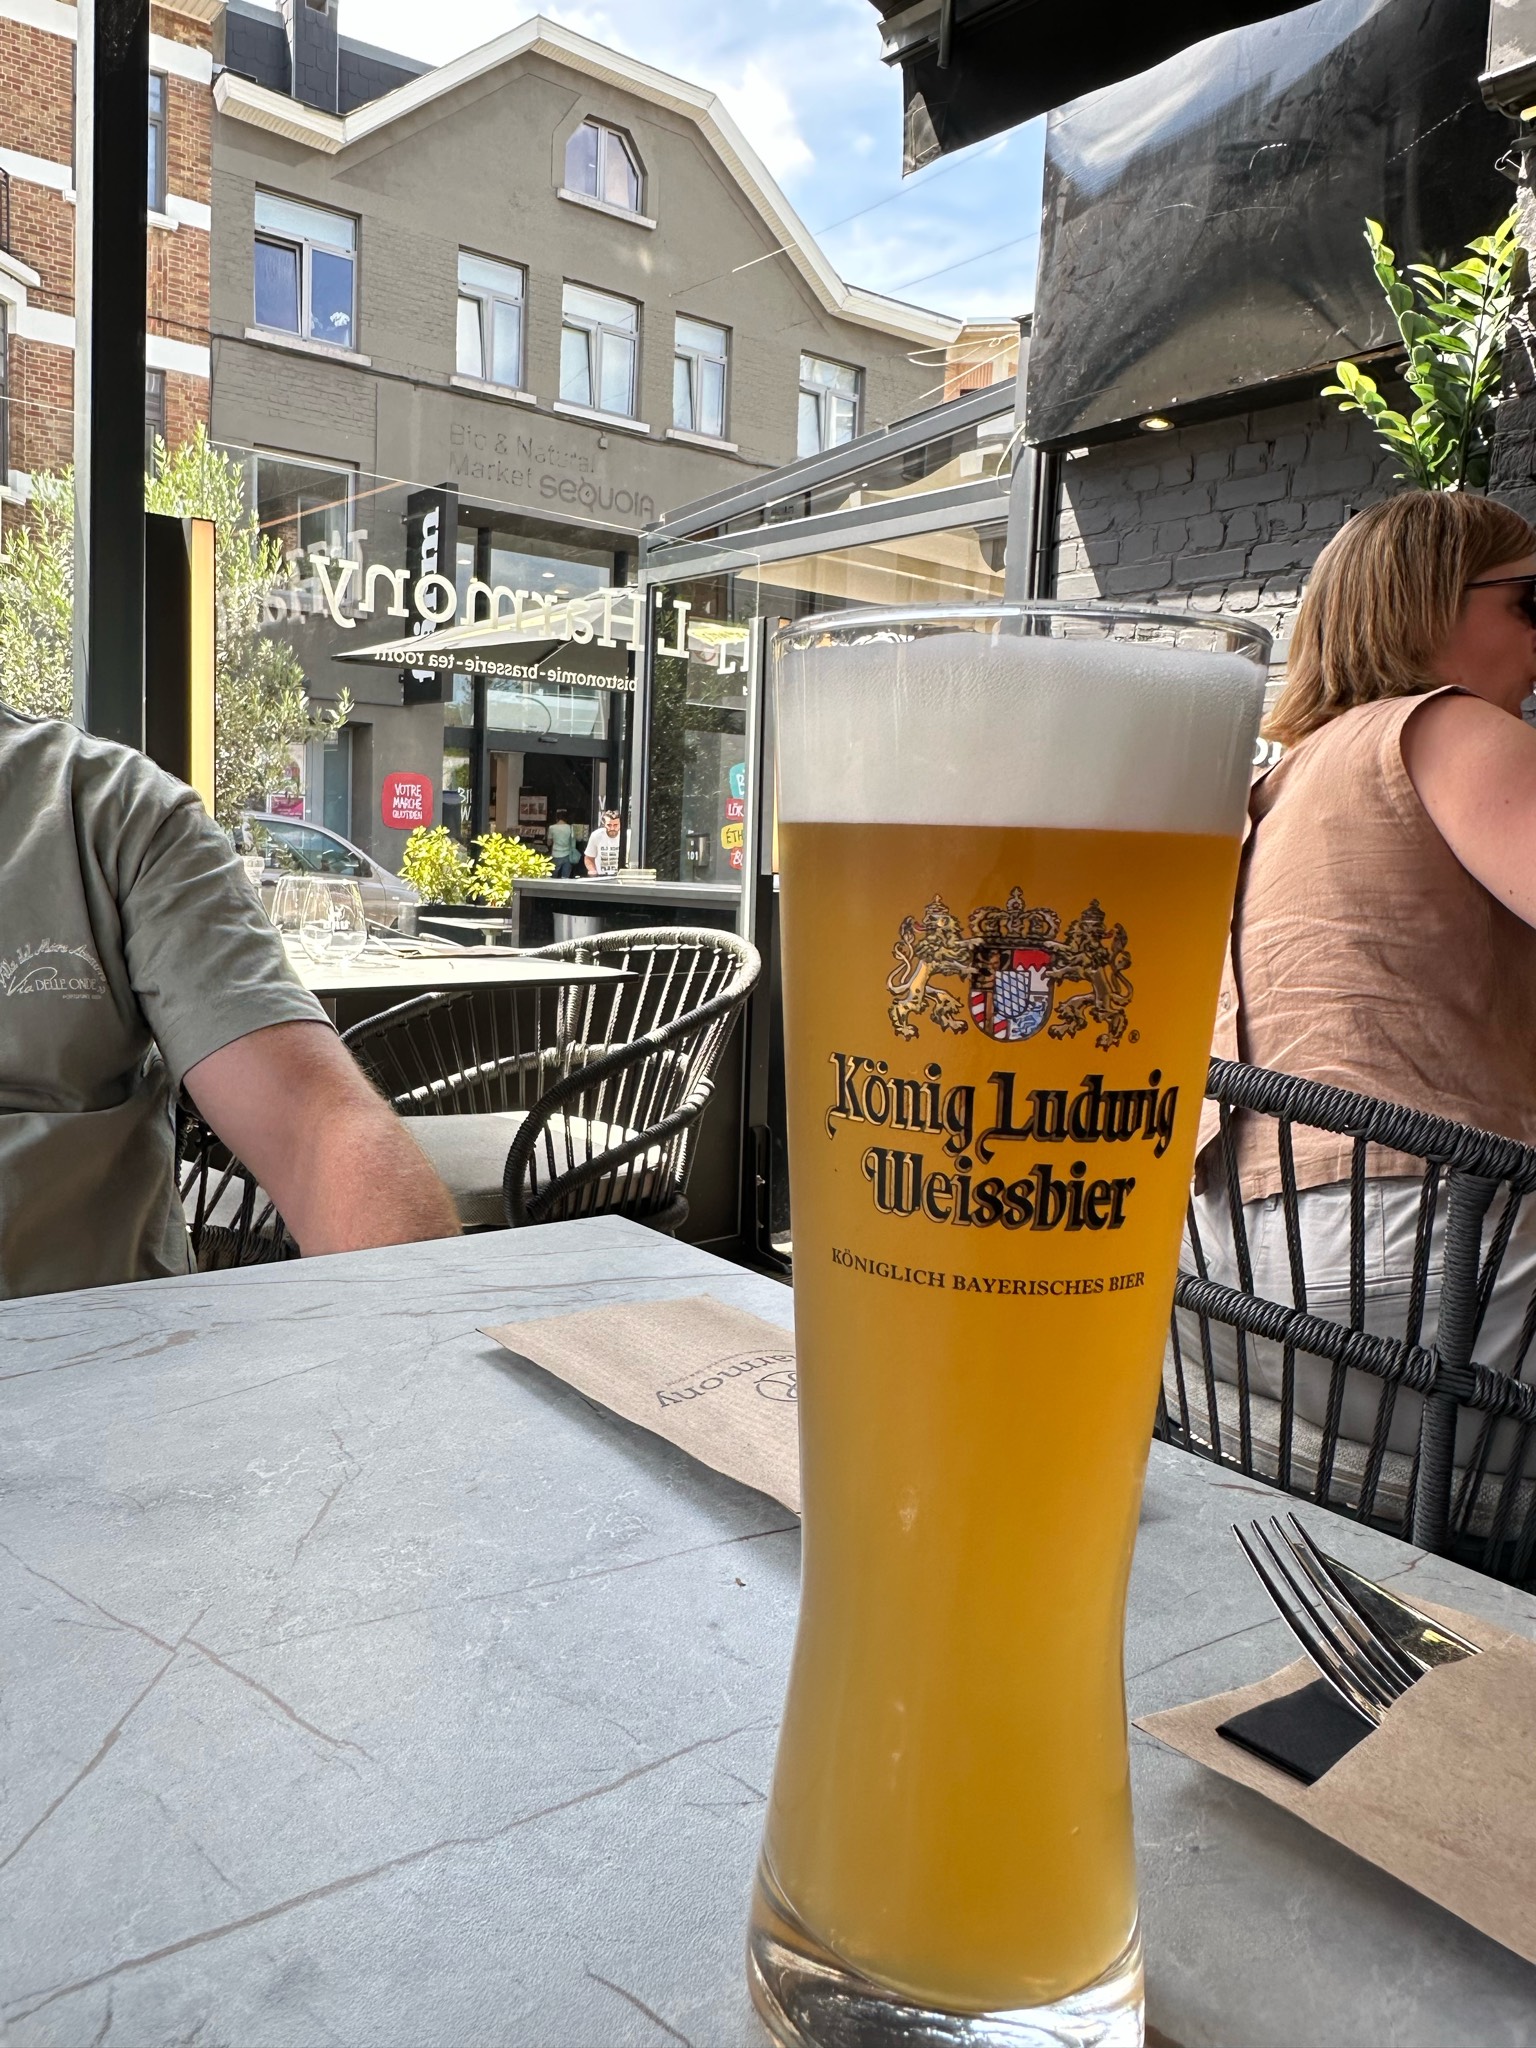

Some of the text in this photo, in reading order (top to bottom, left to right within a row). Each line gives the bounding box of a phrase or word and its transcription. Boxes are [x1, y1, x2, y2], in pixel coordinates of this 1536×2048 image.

[449, 452, 533, 489] Market
[516, 436, 596, 473] Natural
[394, 783, 422, 797] VOTRE
[35, 979, 68, 991] DELLE
[825, 1051, 1180, 1165] König Ludwig
[860, 1146, 1136, 1232] Weissbier
[831, 1247, 1146, 1297] KÖNIGLICH BAYERISCHES BIER
[655, 1354, 796, 1408] armony
